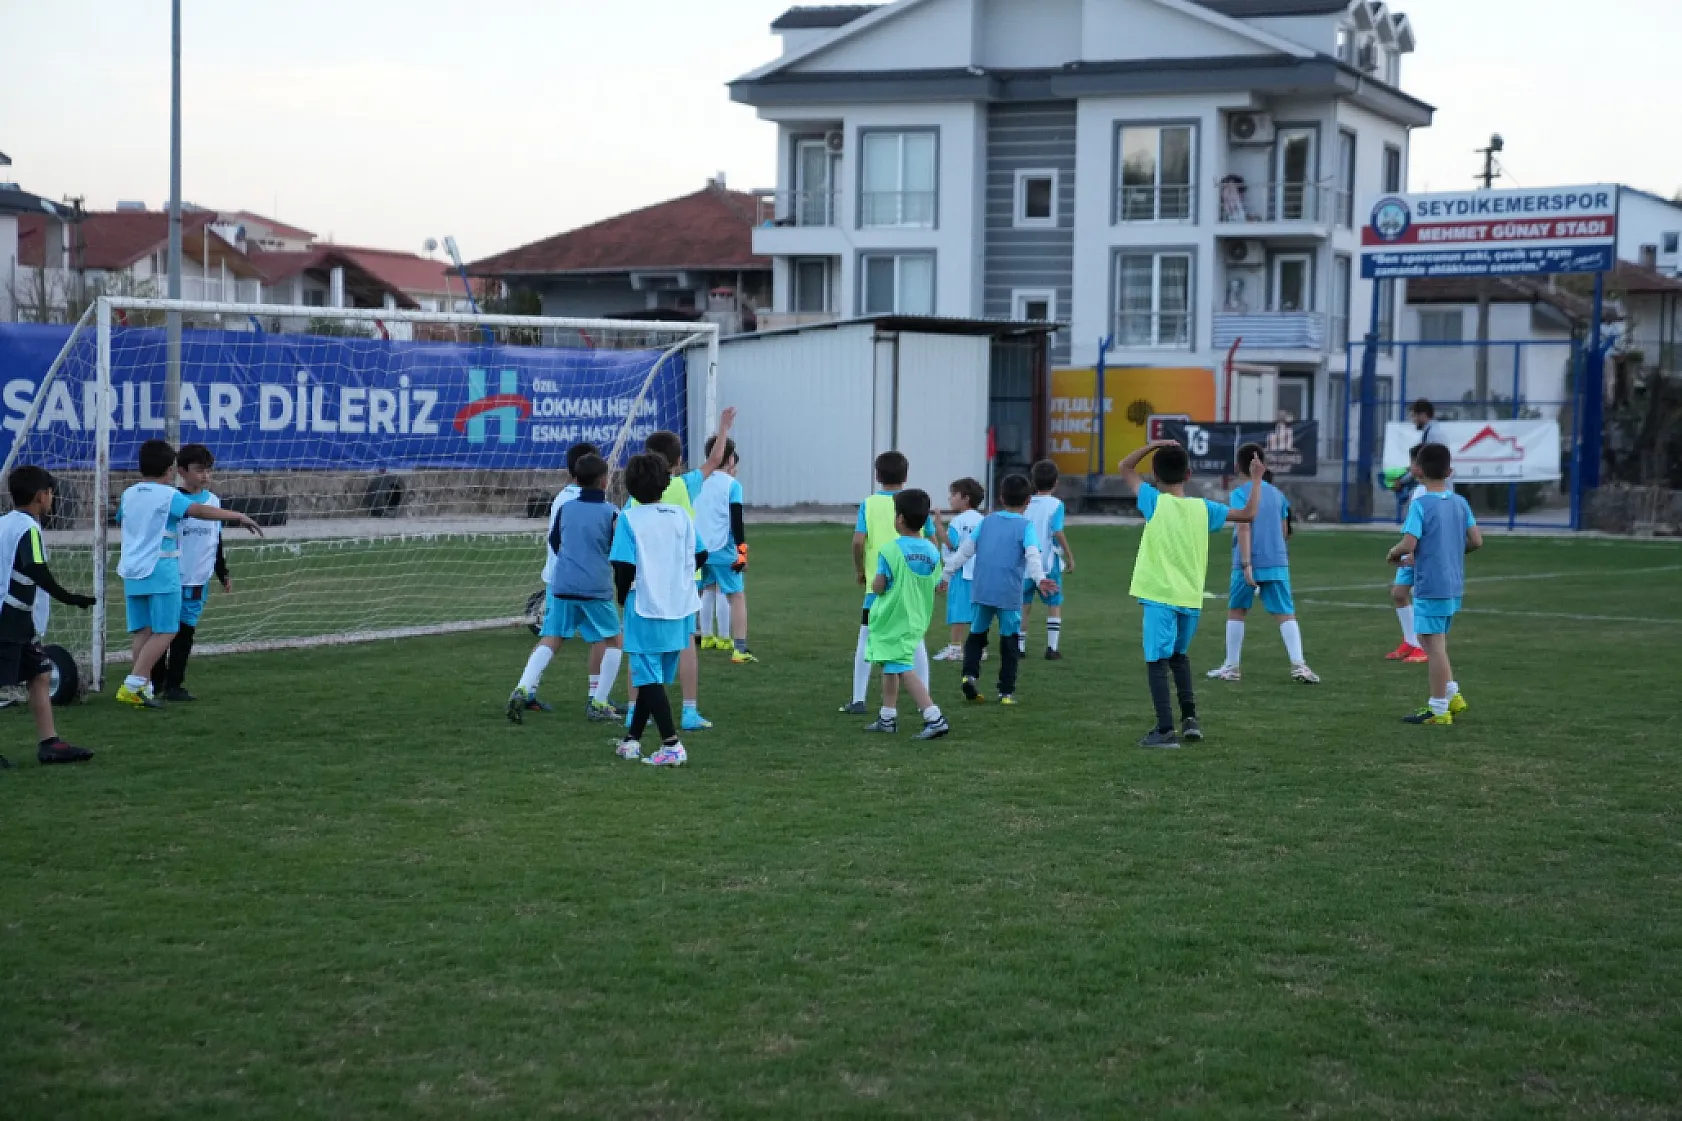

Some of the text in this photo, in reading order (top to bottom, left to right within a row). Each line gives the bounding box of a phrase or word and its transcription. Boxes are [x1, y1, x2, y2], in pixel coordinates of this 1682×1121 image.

[1416, 192, 1608, 216] SEYDİKEMERSPOR
[1417, 225, 1488, 241] MEHMET
[1491, 221, 1550, 238] GÜNAY
[1, 370, 438, 444] ŞARILAR DİLERİZ
[533, 397, 603, 417] LOKMAN
[533, 425, 579, 442] ESNAF
